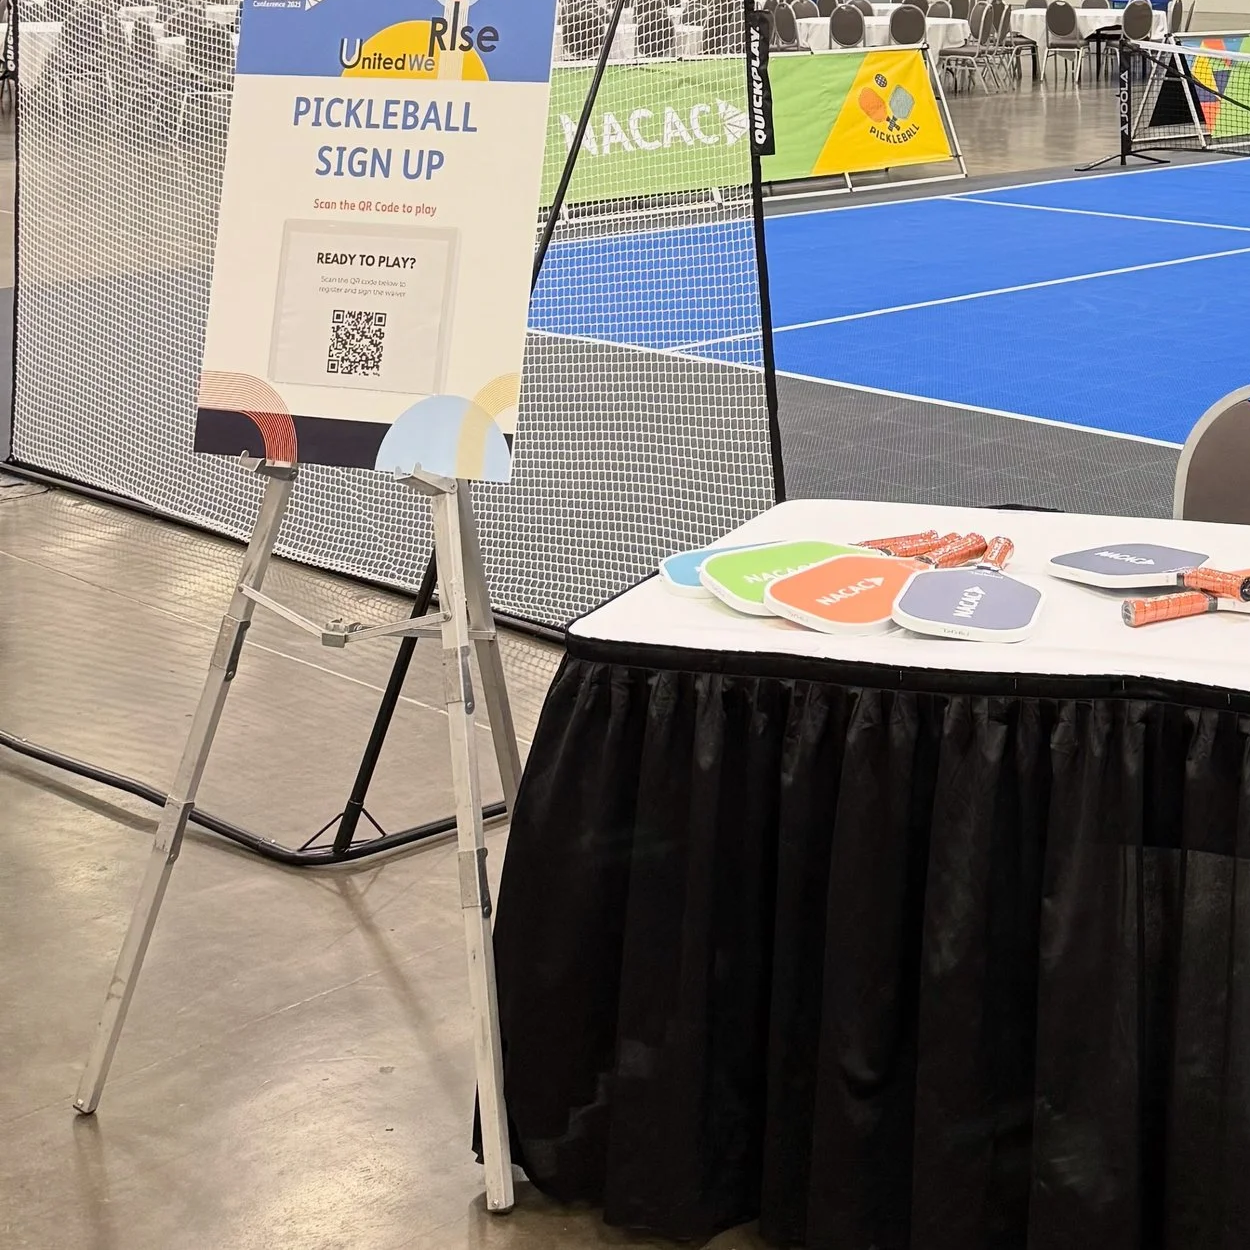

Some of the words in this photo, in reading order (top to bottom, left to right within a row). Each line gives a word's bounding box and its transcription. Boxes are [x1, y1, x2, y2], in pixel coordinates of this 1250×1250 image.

[253, 0, 285, 8] Conference
[1120, 70, 1129, 122] JOOLA
[293, 96, 478, 133] PICKLEBALL
[559, 103, 721, 157] NACAC
[869, 123, 920, 144] PICKLEBALL
[315, 146, 392, 179] SIGN
[402, 149, 444, 180] UP
[314, 199, 337, 210] Scan
[339, 200, 356, 211] the
[358, 201, 372, 212] QR
[375, 202, 399, 213] Code
[402, 204, 413, 214] to
[415, 204, 437, 217] play
[316, 252, 356, 265] READY
[359, 255, 375, 266] TO
[378, 256, 416, 269] PLAY?
[816, 579, 874, 607] NACAC
[953, 591, 984, 618] NACAC
